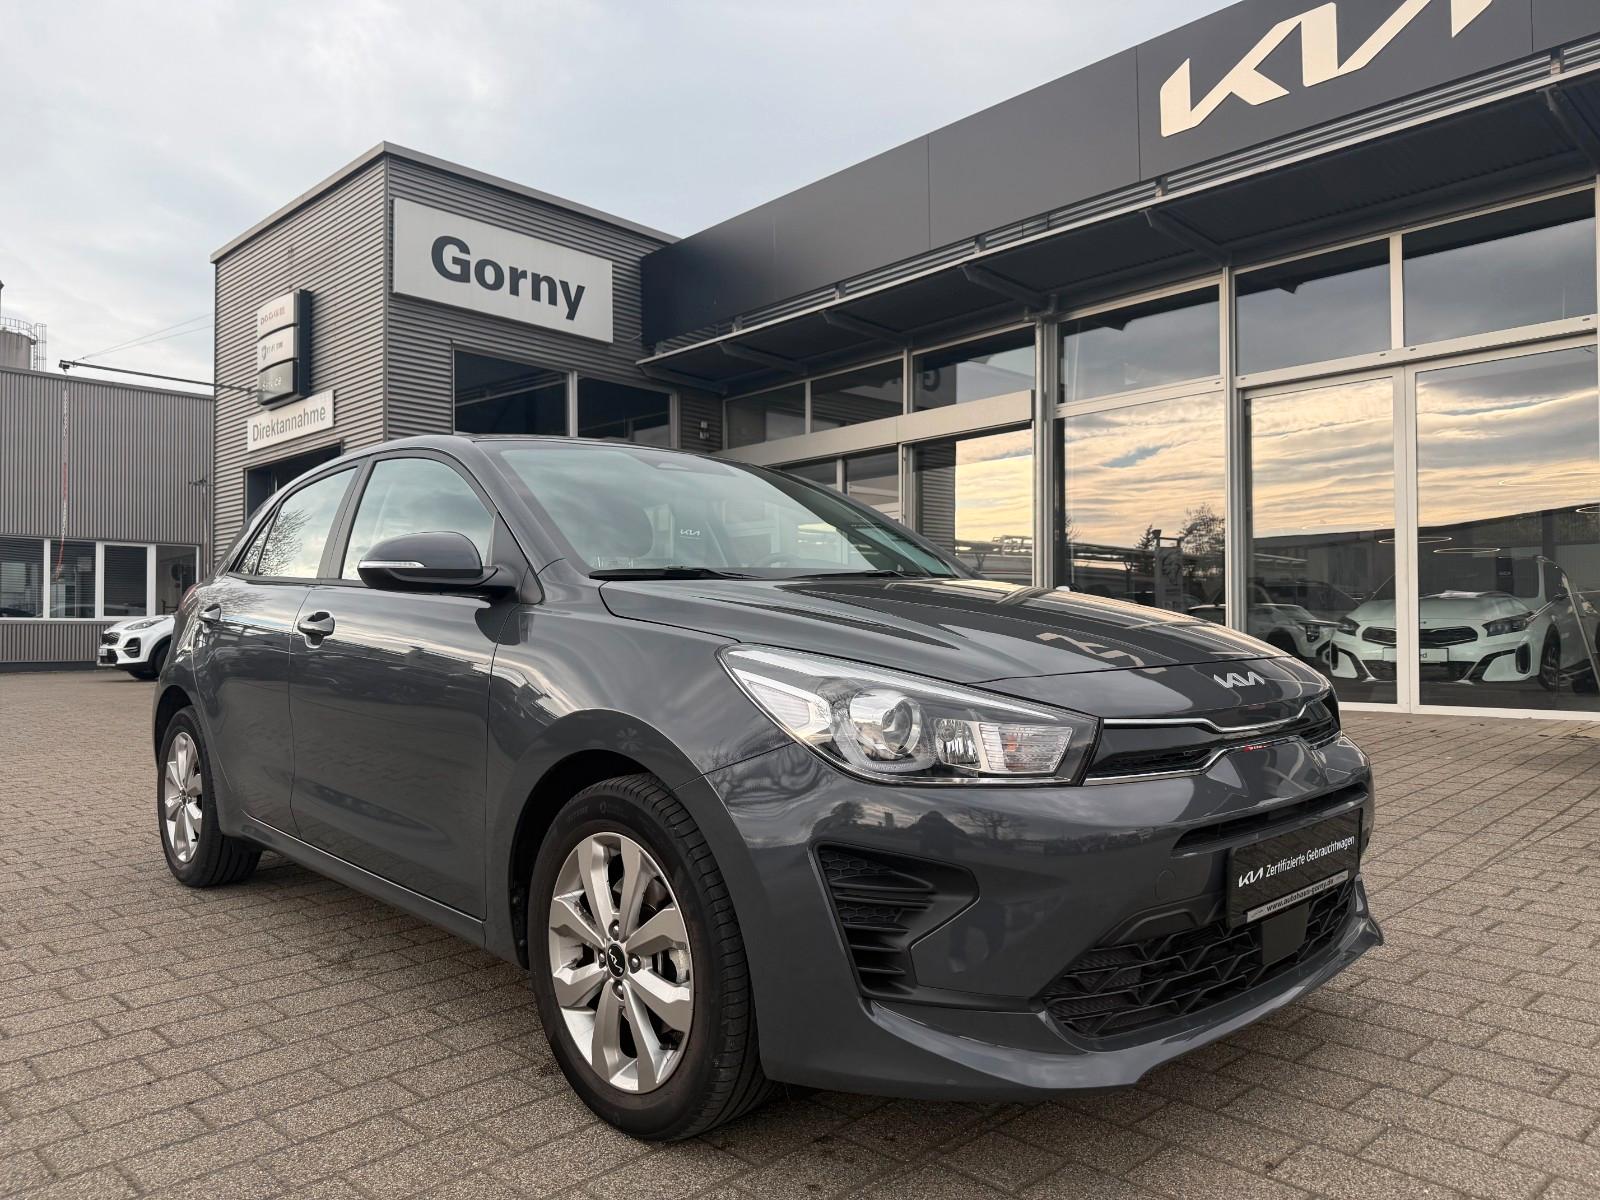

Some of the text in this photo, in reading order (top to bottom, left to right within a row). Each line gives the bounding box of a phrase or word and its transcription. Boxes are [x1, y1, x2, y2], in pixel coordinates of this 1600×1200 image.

[431, 235, 586, 320] Gorny
[252, 406, 326, 442] Direktannahme
[1213, 671, 1265, 689] KIA
[1238, 835, 1355, 888] KIA Zertifizierte Gebrauchtwagen
